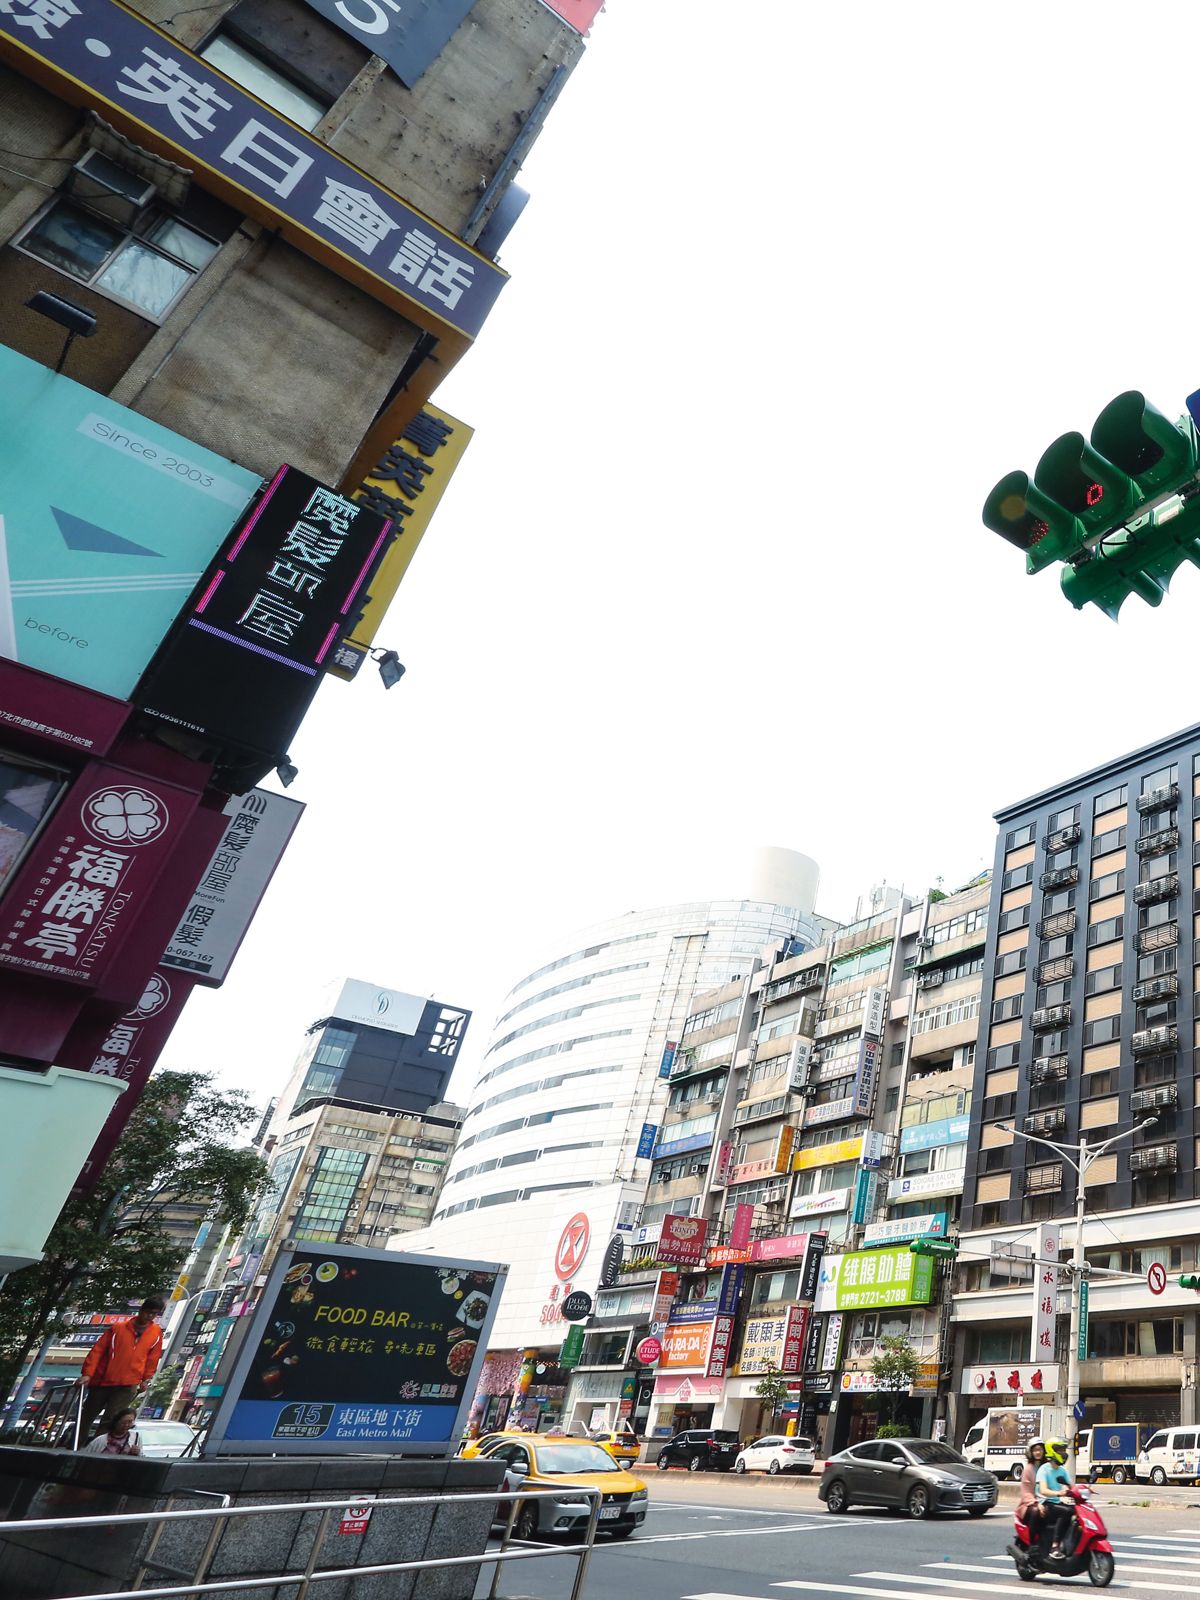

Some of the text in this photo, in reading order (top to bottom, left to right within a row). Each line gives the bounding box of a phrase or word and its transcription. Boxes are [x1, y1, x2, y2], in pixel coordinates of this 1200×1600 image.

[116, 46, 476, 311] 英日會話
[92, 421, 216, 490] Since 2003
[23, 616, 90, 650] before
[23, 844, 130, 960] 福勝亭
[80, 891, 133, 969] TONKATSU
[174, 904, 216, 948] 假髮
[657, 1252, 699, 1265] 8771-5643
[860, 1288, 907, 1306] 2721-3789
[314, 1305, 368, 1325] FOOD
[370, 1310, 410, 1328] BAR
[783, 1308, 806, 1370] 戴爾美語
[668, 1351, 689, 1361] factory
[293, 1404, 322, 1425] 15
[338, 1408, 423, 1427] 東區地下街
[336, 1427, 412, 1438] East Metro Mall
